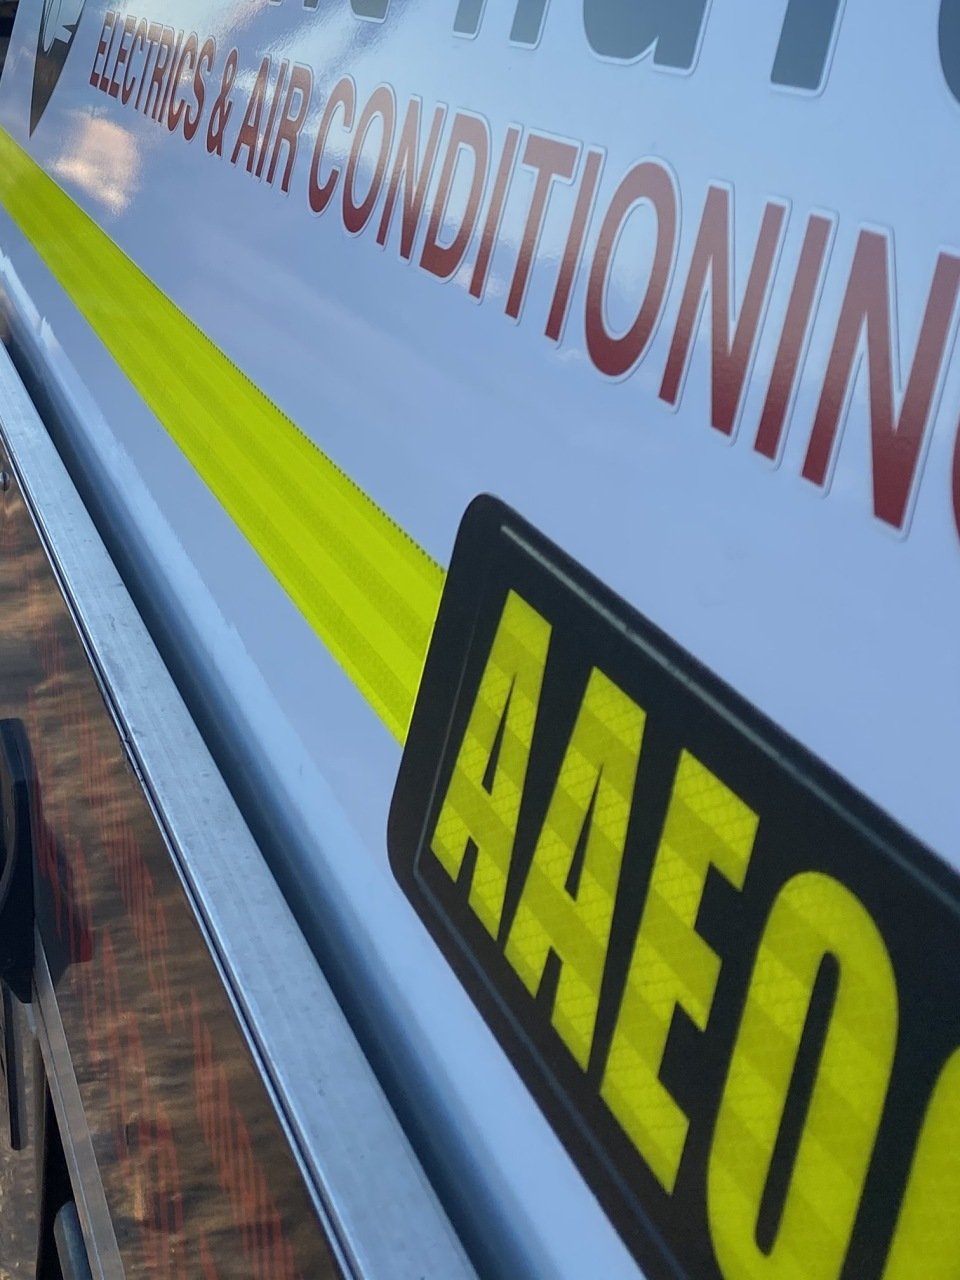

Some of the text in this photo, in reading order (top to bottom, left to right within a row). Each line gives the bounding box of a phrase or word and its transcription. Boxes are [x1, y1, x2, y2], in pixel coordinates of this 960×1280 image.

[89, 10, 960, 550] ELECTRICS & AIR CONDITIONIN
